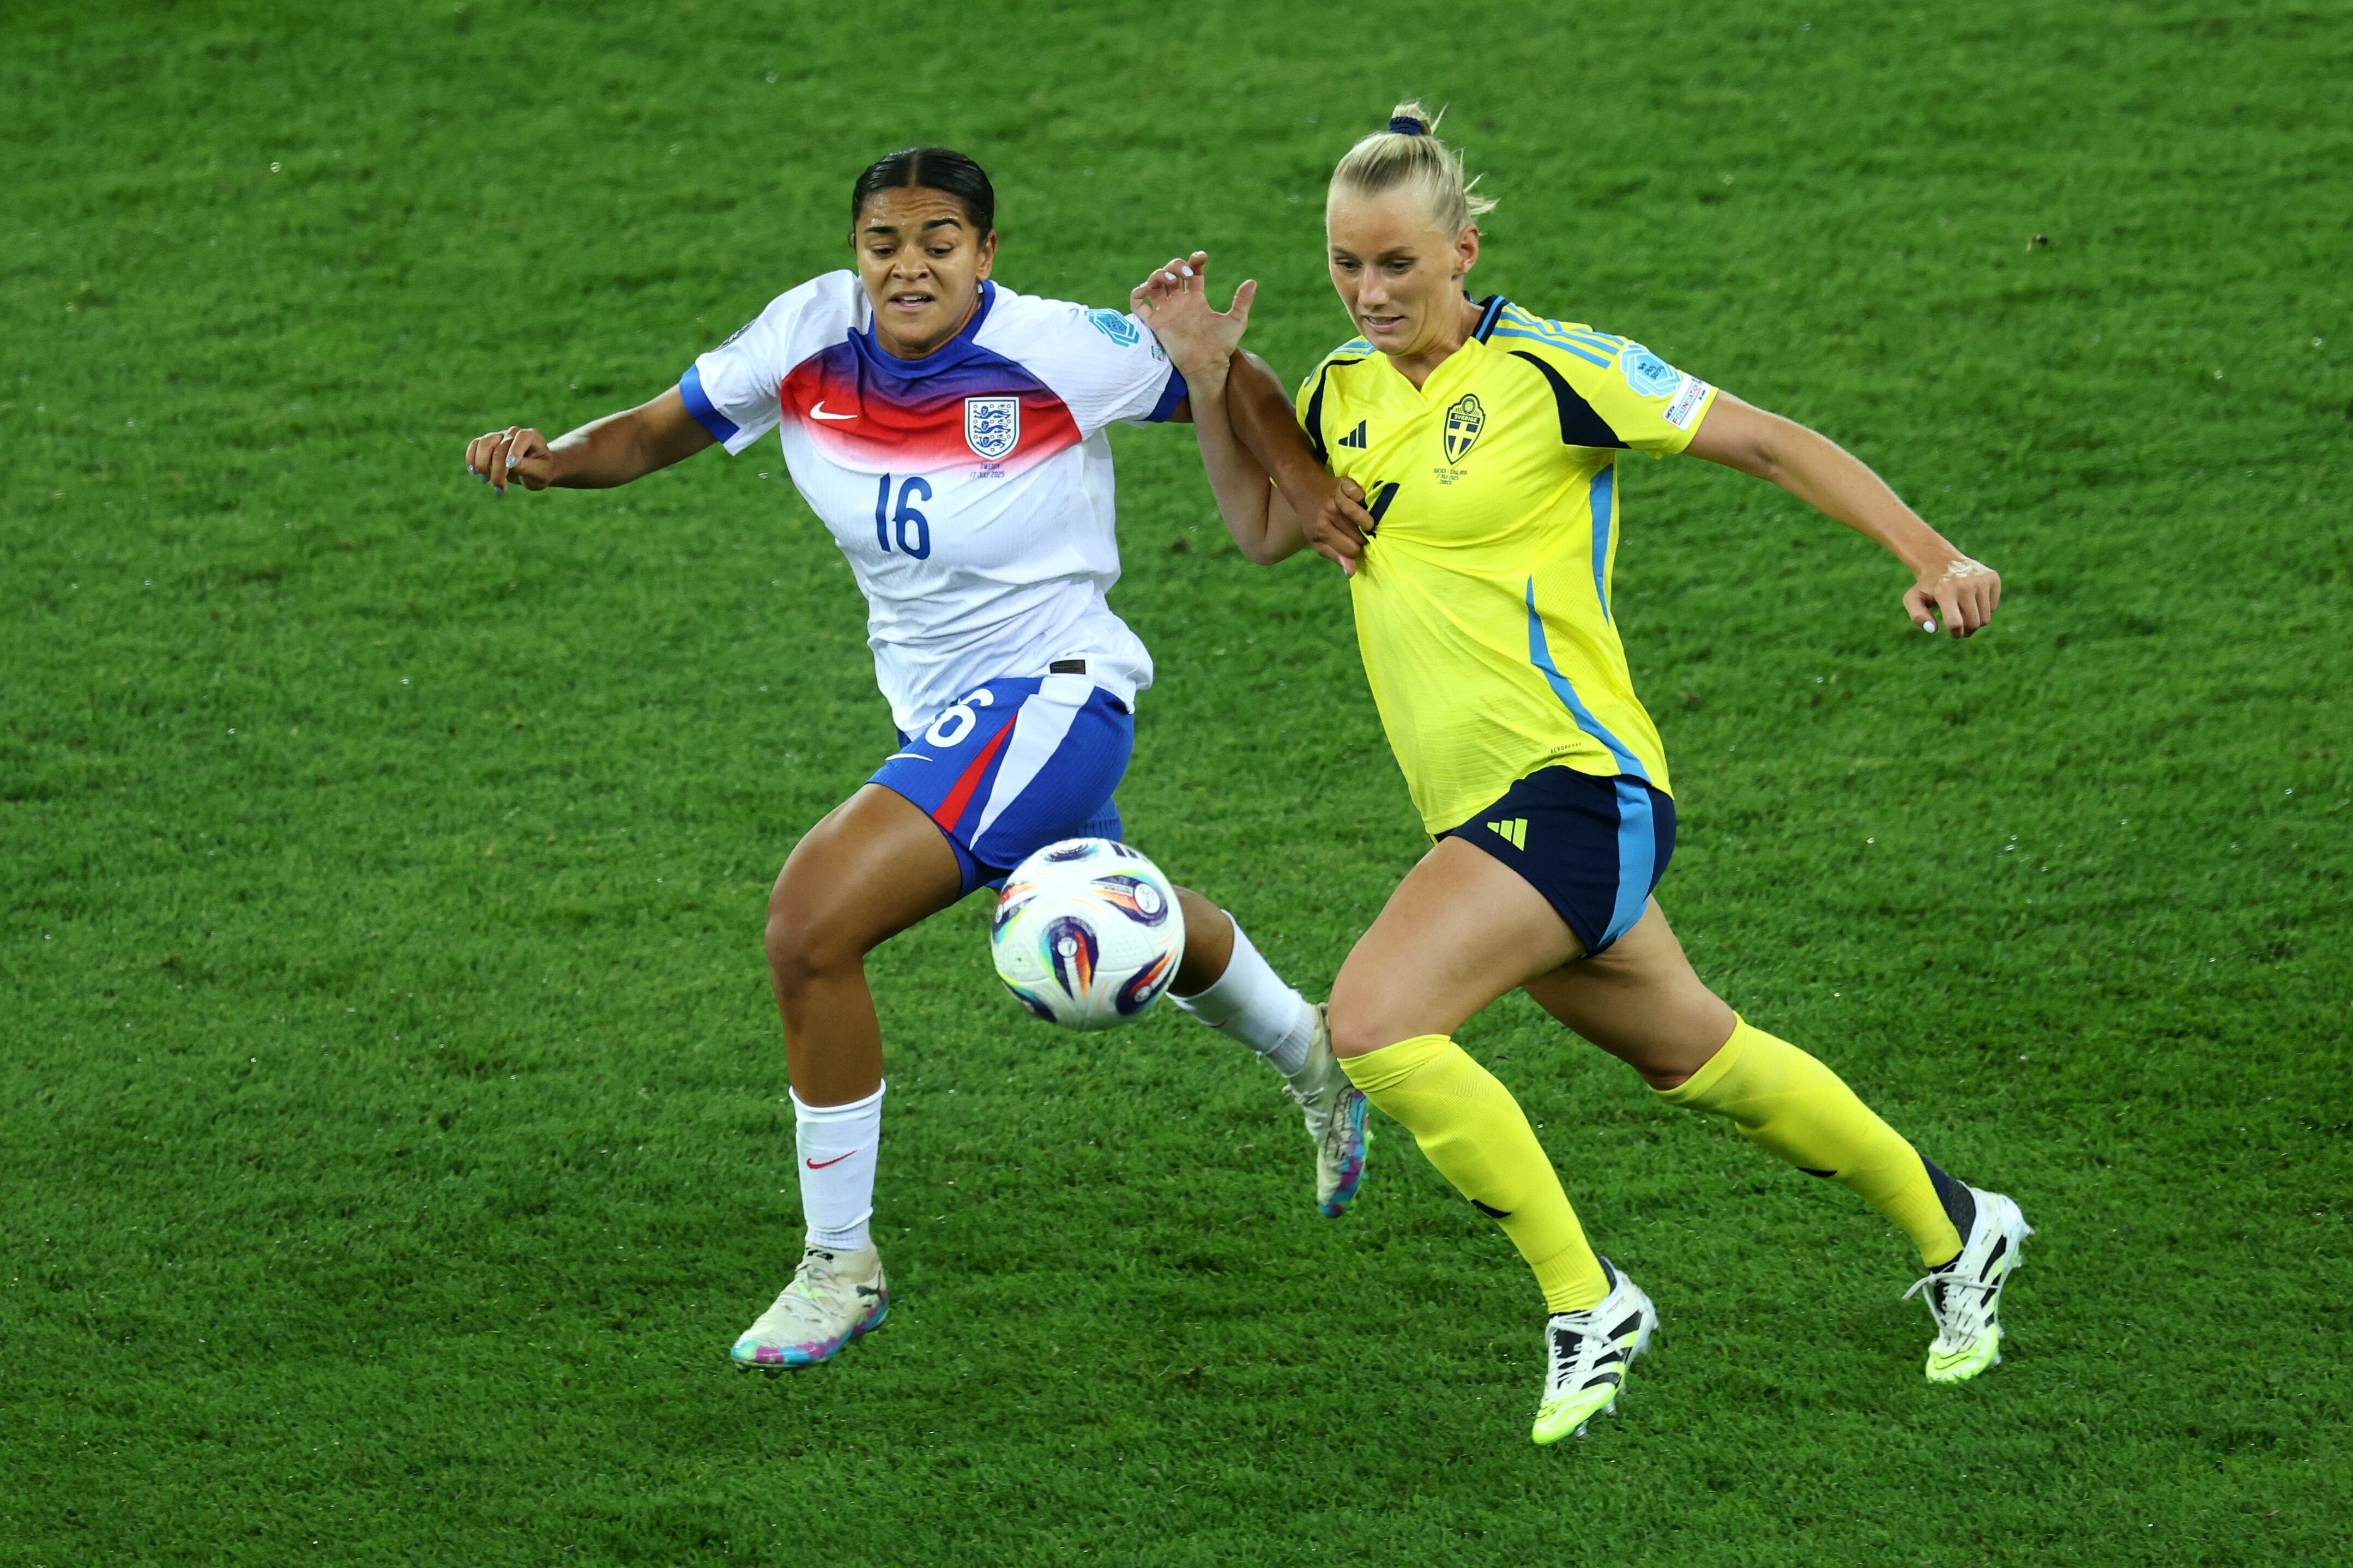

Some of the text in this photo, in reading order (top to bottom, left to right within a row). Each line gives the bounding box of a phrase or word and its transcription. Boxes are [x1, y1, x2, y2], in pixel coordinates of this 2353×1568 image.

[1453, 414, 1478, 423] SVERIGE
[1672, 384, 1698, 424] FOUNDATIO
[876, 472, 932, 560] 16
